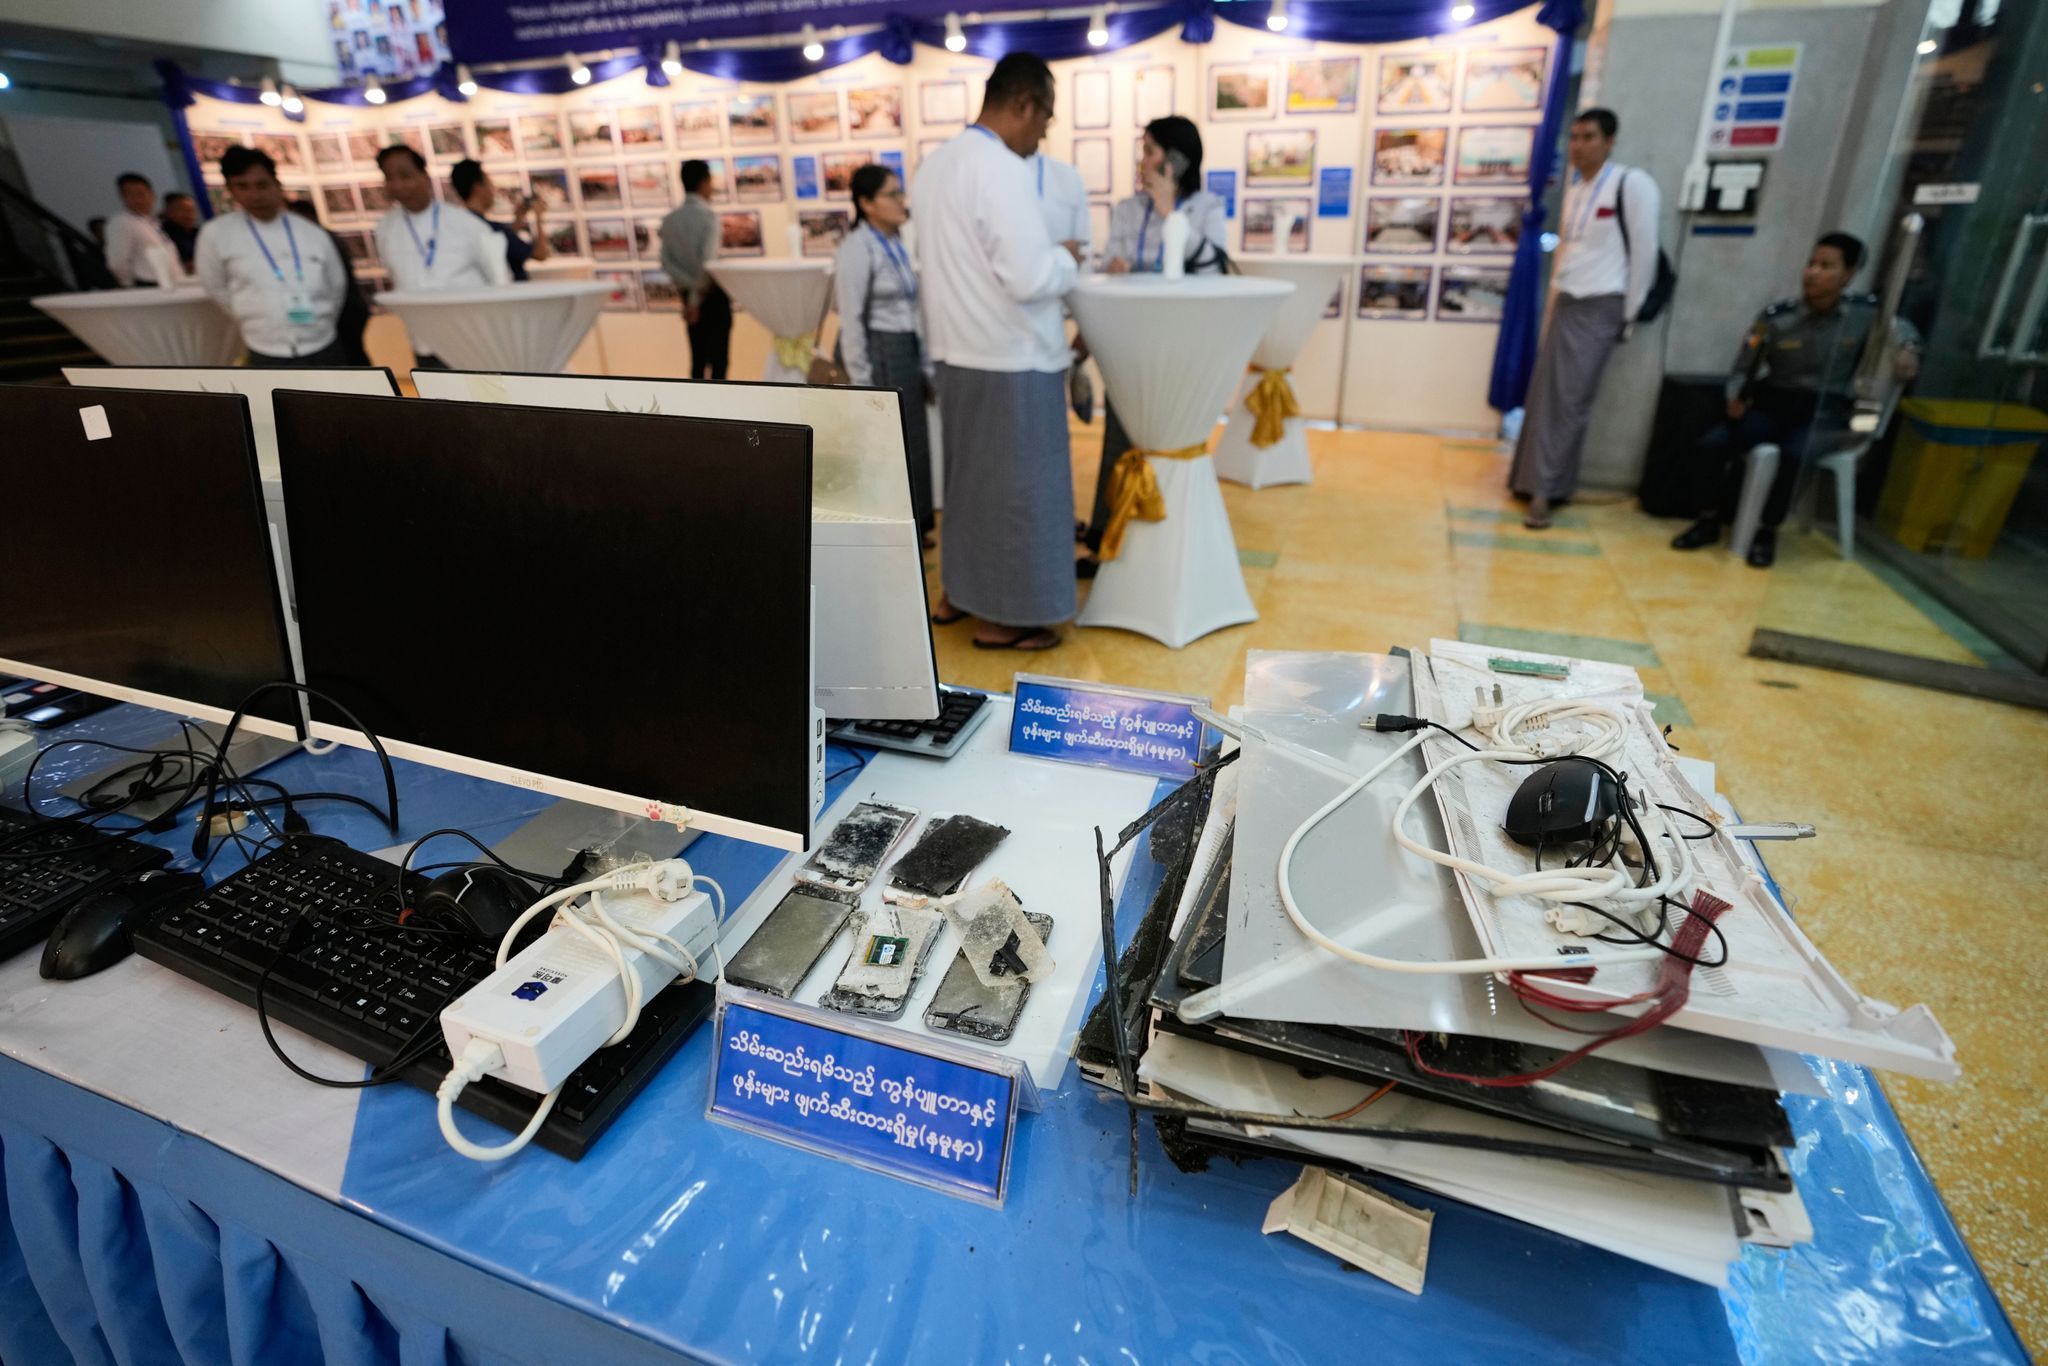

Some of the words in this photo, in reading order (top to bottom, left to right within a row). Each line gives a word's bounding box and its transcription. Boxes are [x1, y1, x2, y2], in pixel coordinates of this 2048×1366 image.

[729, 1030, 875, 1096] သိမ်းဆည်းရမိသည့်
[733, 1071, 790, 1106] ဖုန်းများ
